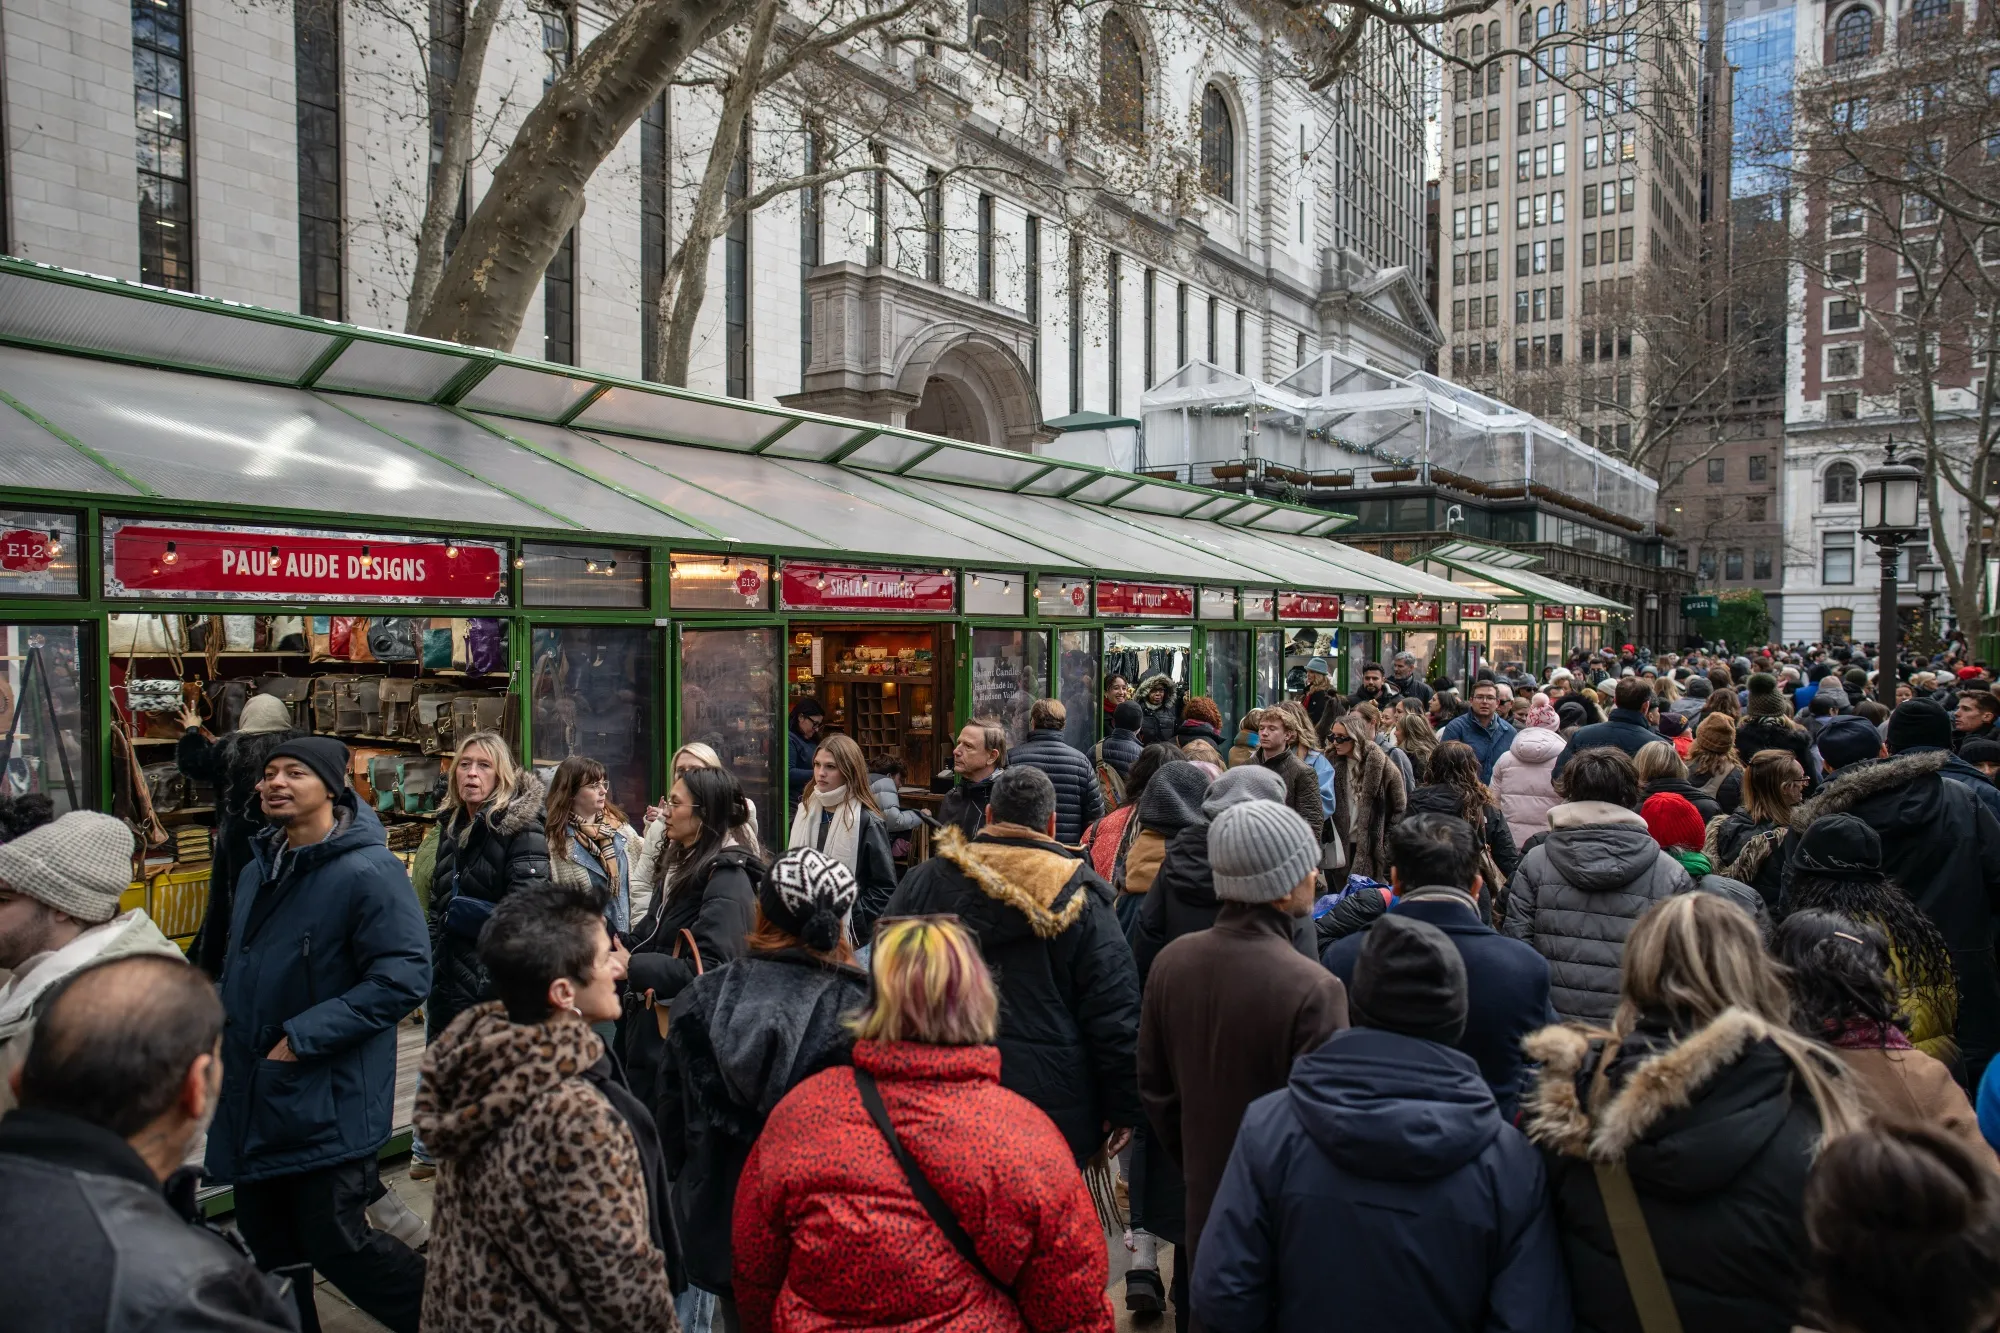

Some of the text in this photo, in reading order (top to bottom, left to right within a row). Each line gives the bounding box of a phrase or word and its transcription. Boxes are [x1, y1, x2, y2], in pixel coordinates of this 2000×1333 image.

[7, 543, 44, 558] E12
[222, 549, 426, 582] PAUL AUDE DESIGNS
[741, 579, 756, 587] E13
[831, 579, 914, 599] SHALANT CANDLES
[1144, 593, 1161, 607] TOUCH
[995, 668, 1022, 677] Candles
[979, 692, 1002, 701] Hudson
